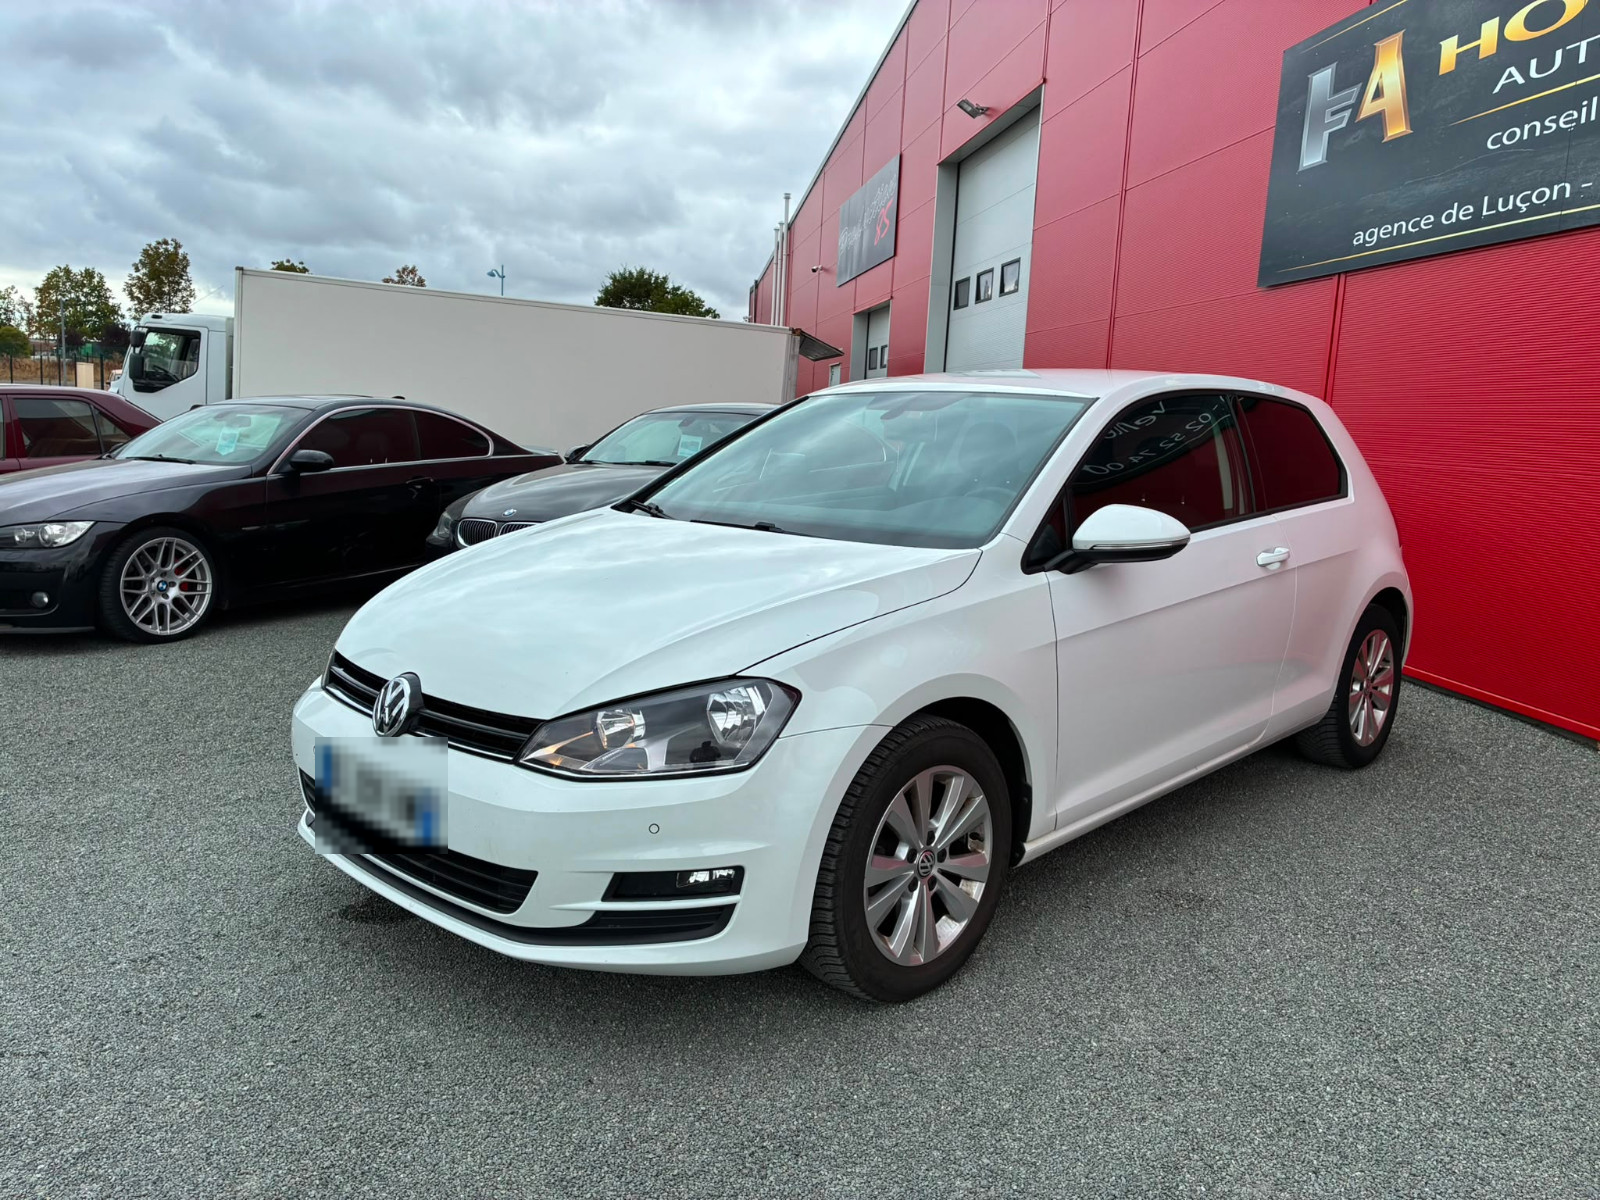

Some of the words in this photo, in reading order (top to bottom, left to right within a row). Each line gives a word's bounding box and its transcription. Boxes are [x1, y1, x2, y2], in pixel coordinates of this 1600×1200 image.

[1486, 95, 1598, 150] conseil
[1352, 213, 1435, 247] agence
[1441, 202, 1474, 224] de
[1481, 182, 1572, 213] Luçon
